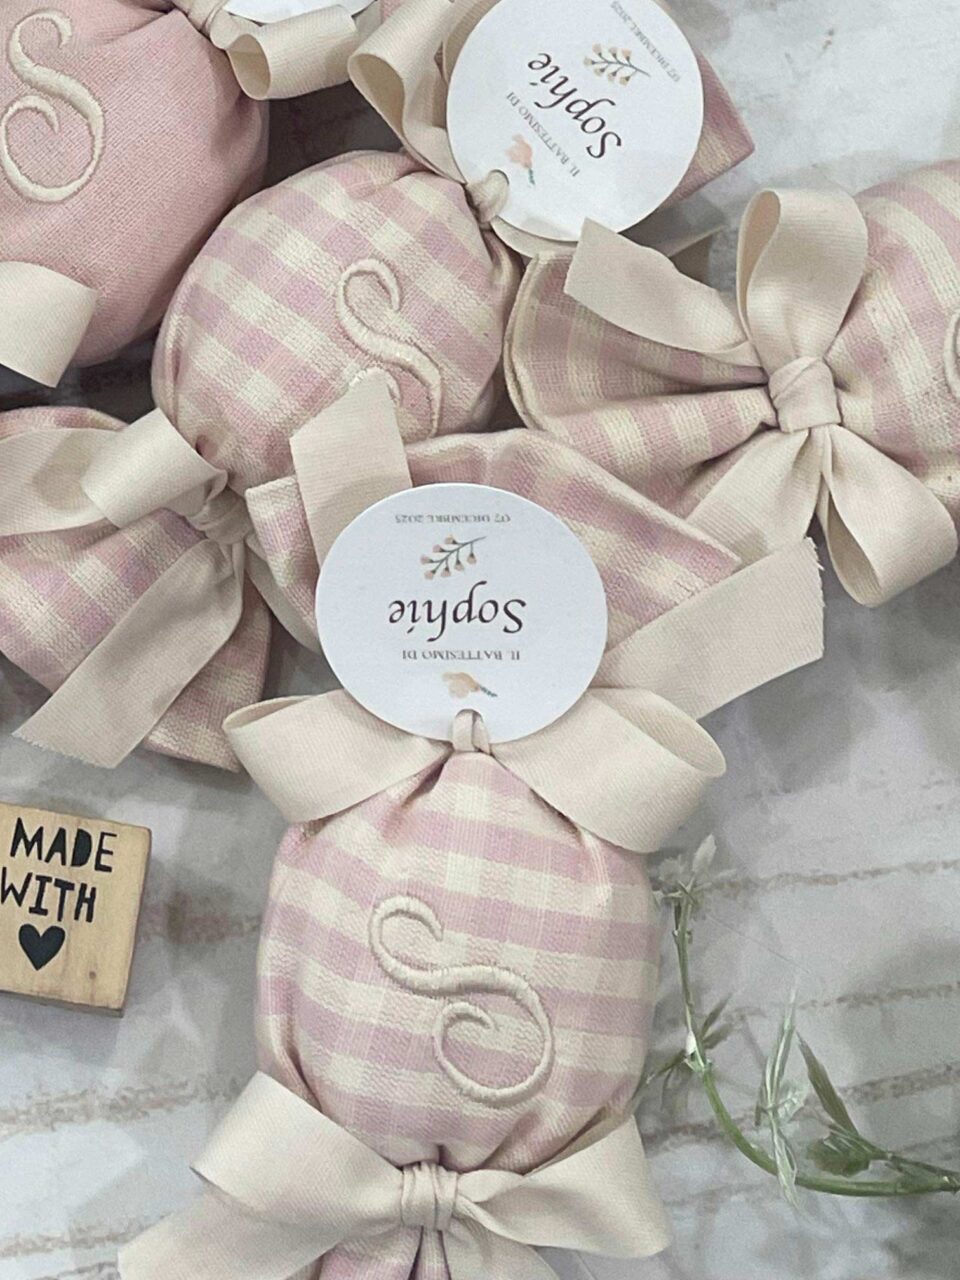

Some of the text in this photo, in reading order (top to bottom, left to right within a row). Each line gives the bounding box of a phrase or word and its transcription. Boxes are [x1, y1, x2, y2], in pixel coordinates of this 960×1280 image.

[527, 52, 622, 159] Sophie
[388, 580, 526, 642] Sophie
[402, 650, 520, 660] IL BATTESIMO DI
[9, 817, 118, 872] MADE
[0, 867, 97, 922] WITH
[368, 893, 554, 1109] S
